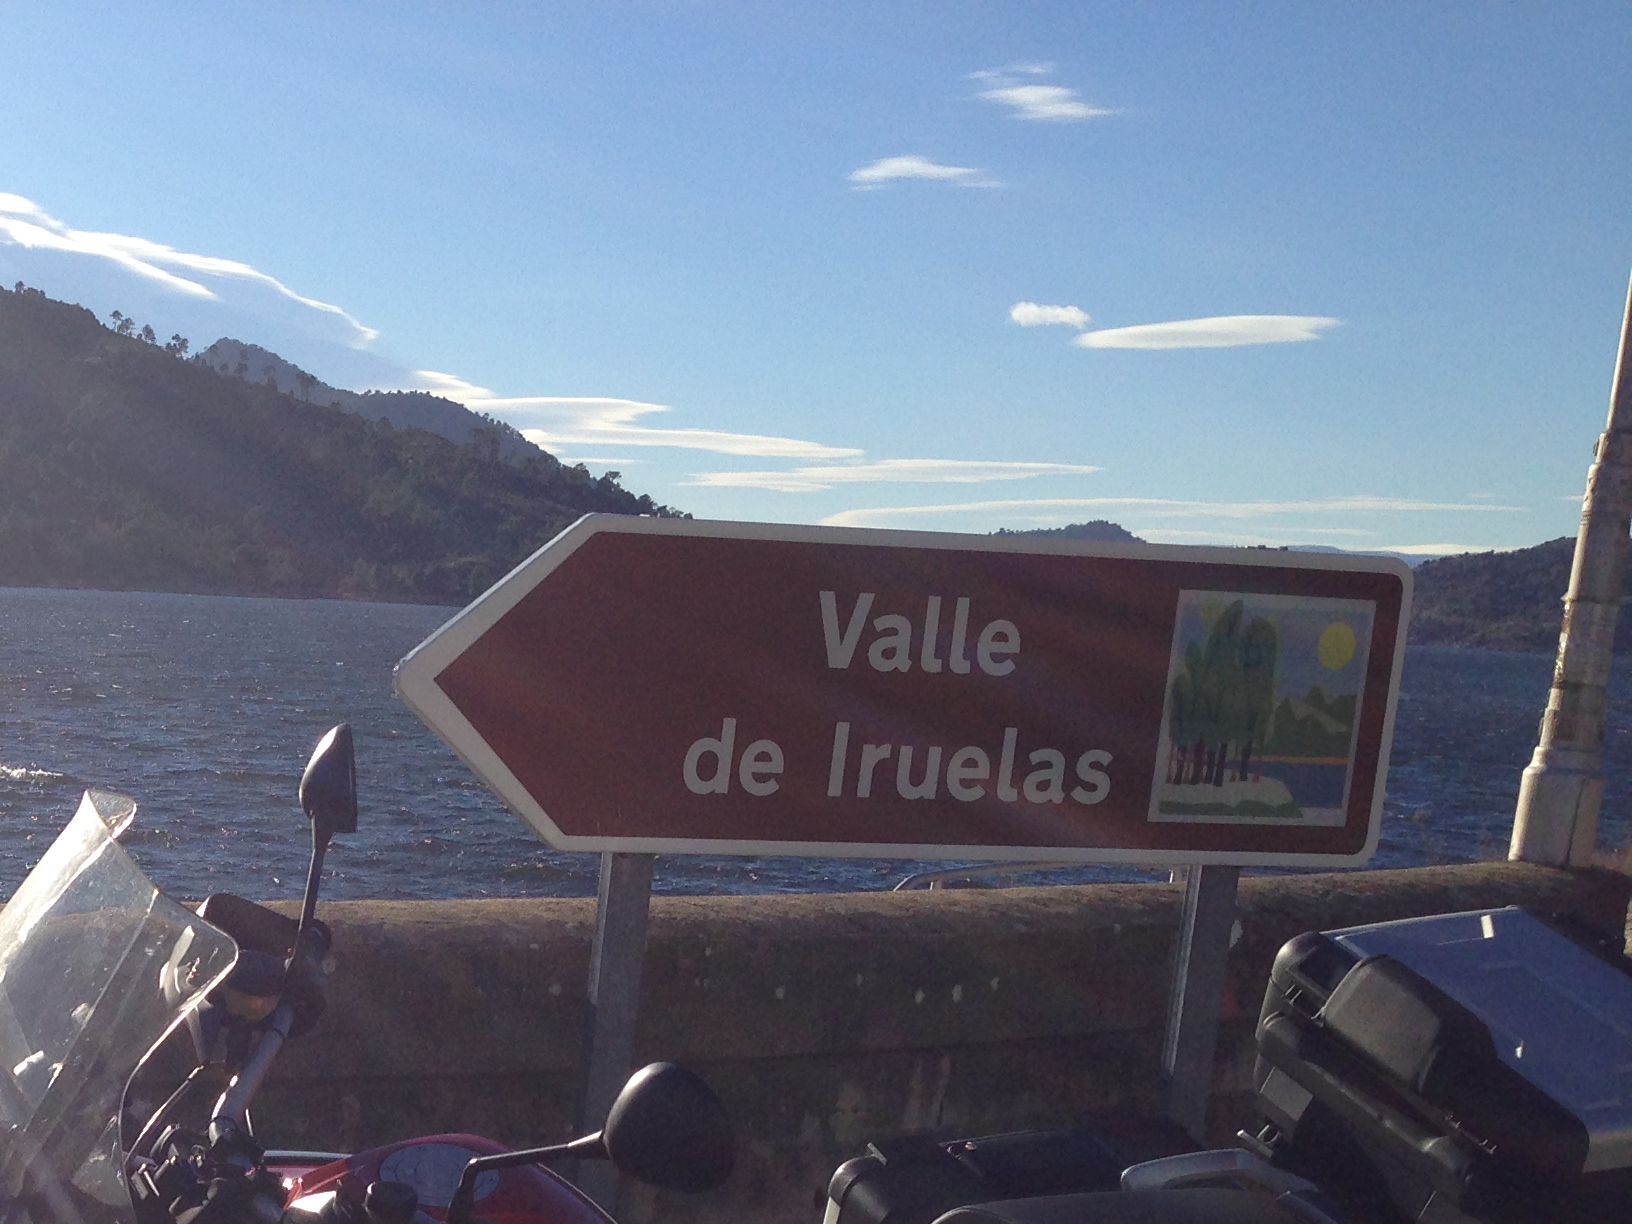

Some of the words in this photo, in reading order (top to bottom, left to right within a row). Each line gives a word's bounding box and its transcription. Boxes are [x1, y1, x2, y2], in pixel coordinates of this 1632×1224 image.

[820, 590, 1021, 676] Valle
[683, 717, 785, 797] de
[827, 721, 1113, 805] Iruelas
